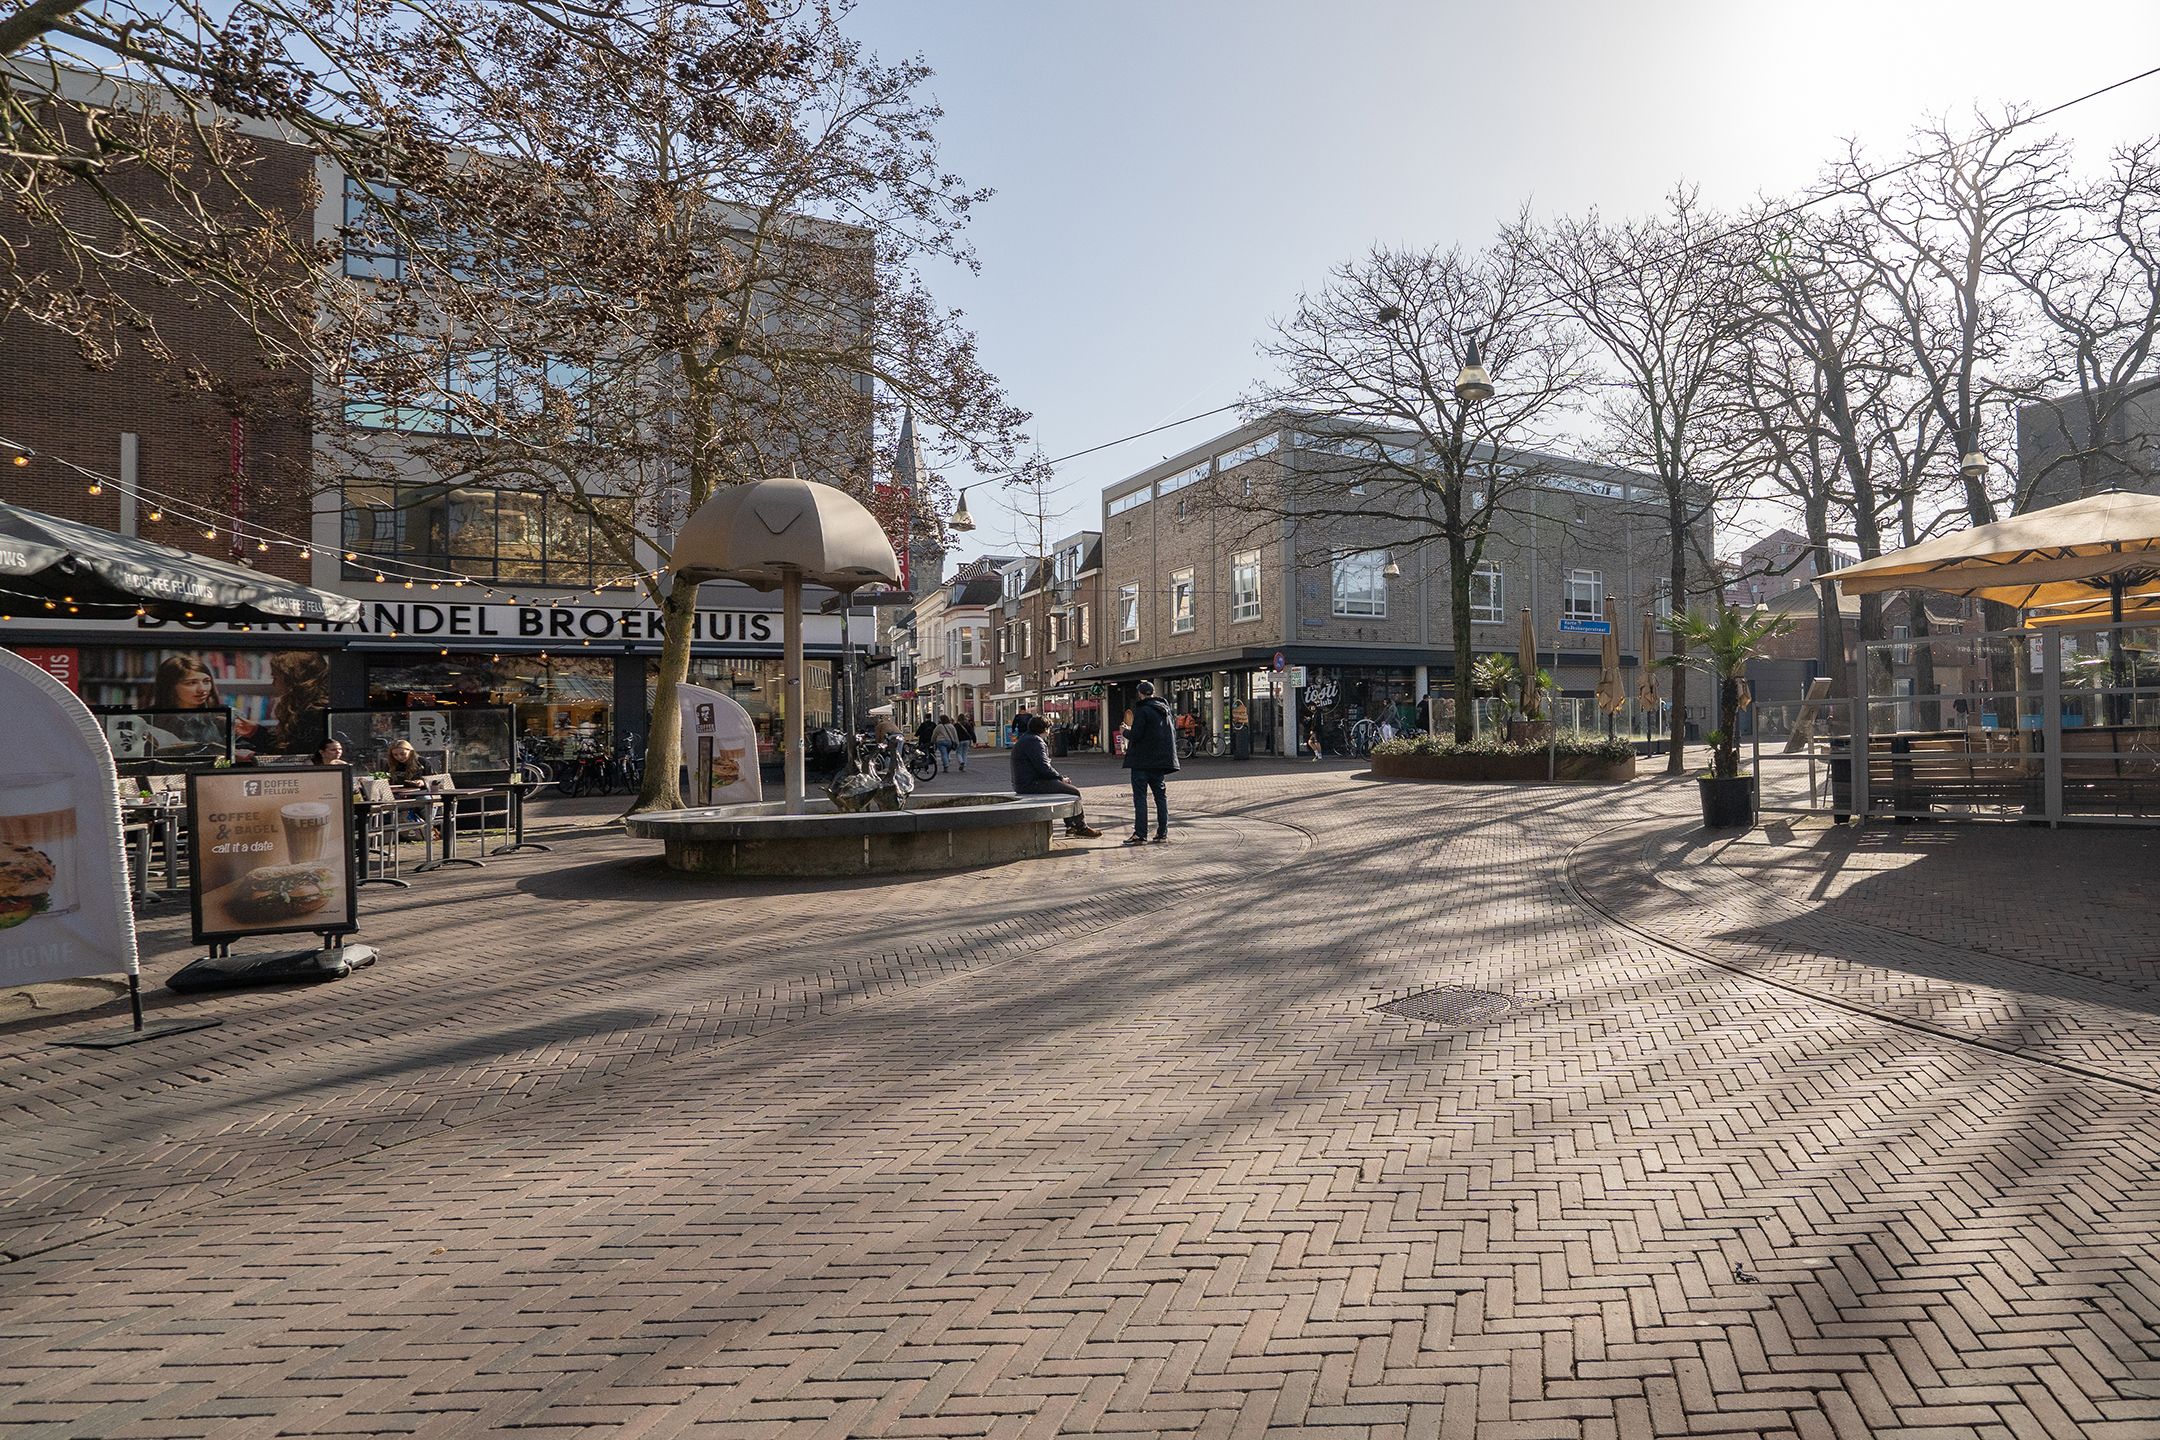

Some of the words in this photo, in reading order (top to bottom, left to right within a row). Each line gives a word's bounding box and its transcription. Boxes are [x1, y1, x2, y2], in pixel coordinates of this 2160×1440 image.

[133, 574, 171, 593] COFFEE
[171, 580, 214, 599] FELLOWS
[278, 596, 305, 612] COFFEE
[50, 654, 69, 685] UIS
[1174, 677, 1202, 692] SPAR
[1304, 680, 1338, 703] tosti
[264, 779, 300, 788] COFFEE
[263, 787, 300, 796] FELLOWS
[208, 811, 260, 823] COFFEE
[216, 823, 231, 840] &
[234, 823, 279, 835] BAGEL
[211, 842, 230, 854] call
[232, 842, 240, 853] it
[241, 844, 249, 853] a
[250, 840, 274, 853] date
